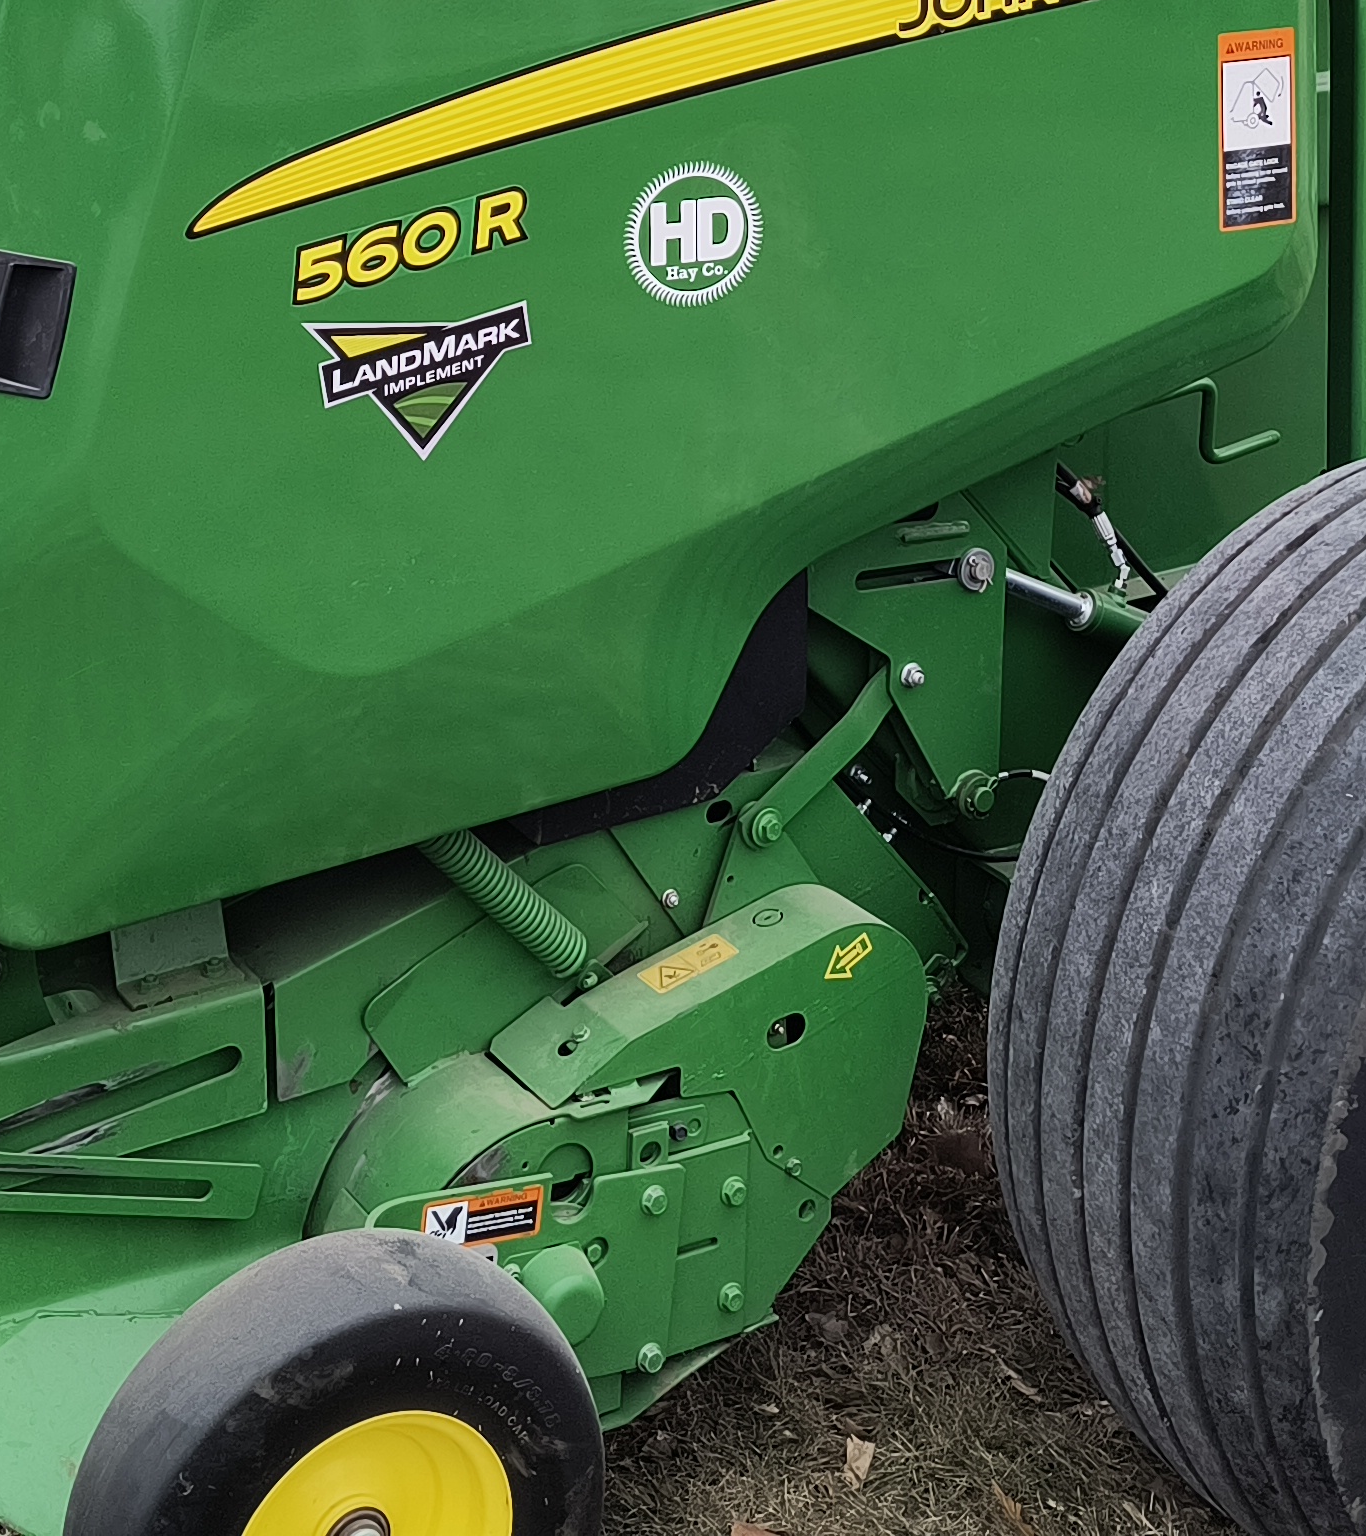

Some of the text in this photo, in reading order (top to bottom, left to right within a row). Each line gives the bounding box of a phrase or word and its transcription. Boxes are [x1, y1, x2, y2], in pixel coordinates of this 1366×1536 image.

[1234, 37, 1284, 53] WARNING
[292, 185, 529, 306] 560 R
[649, 196, 746, 267] HD
[665, 262, 729, 282] Hay Co.
[331, 318, 521, 394] LANDMARK
[383, 354, 485, 397] IMPLEMENT
[486, 1191, 528, 1206] WARNING
